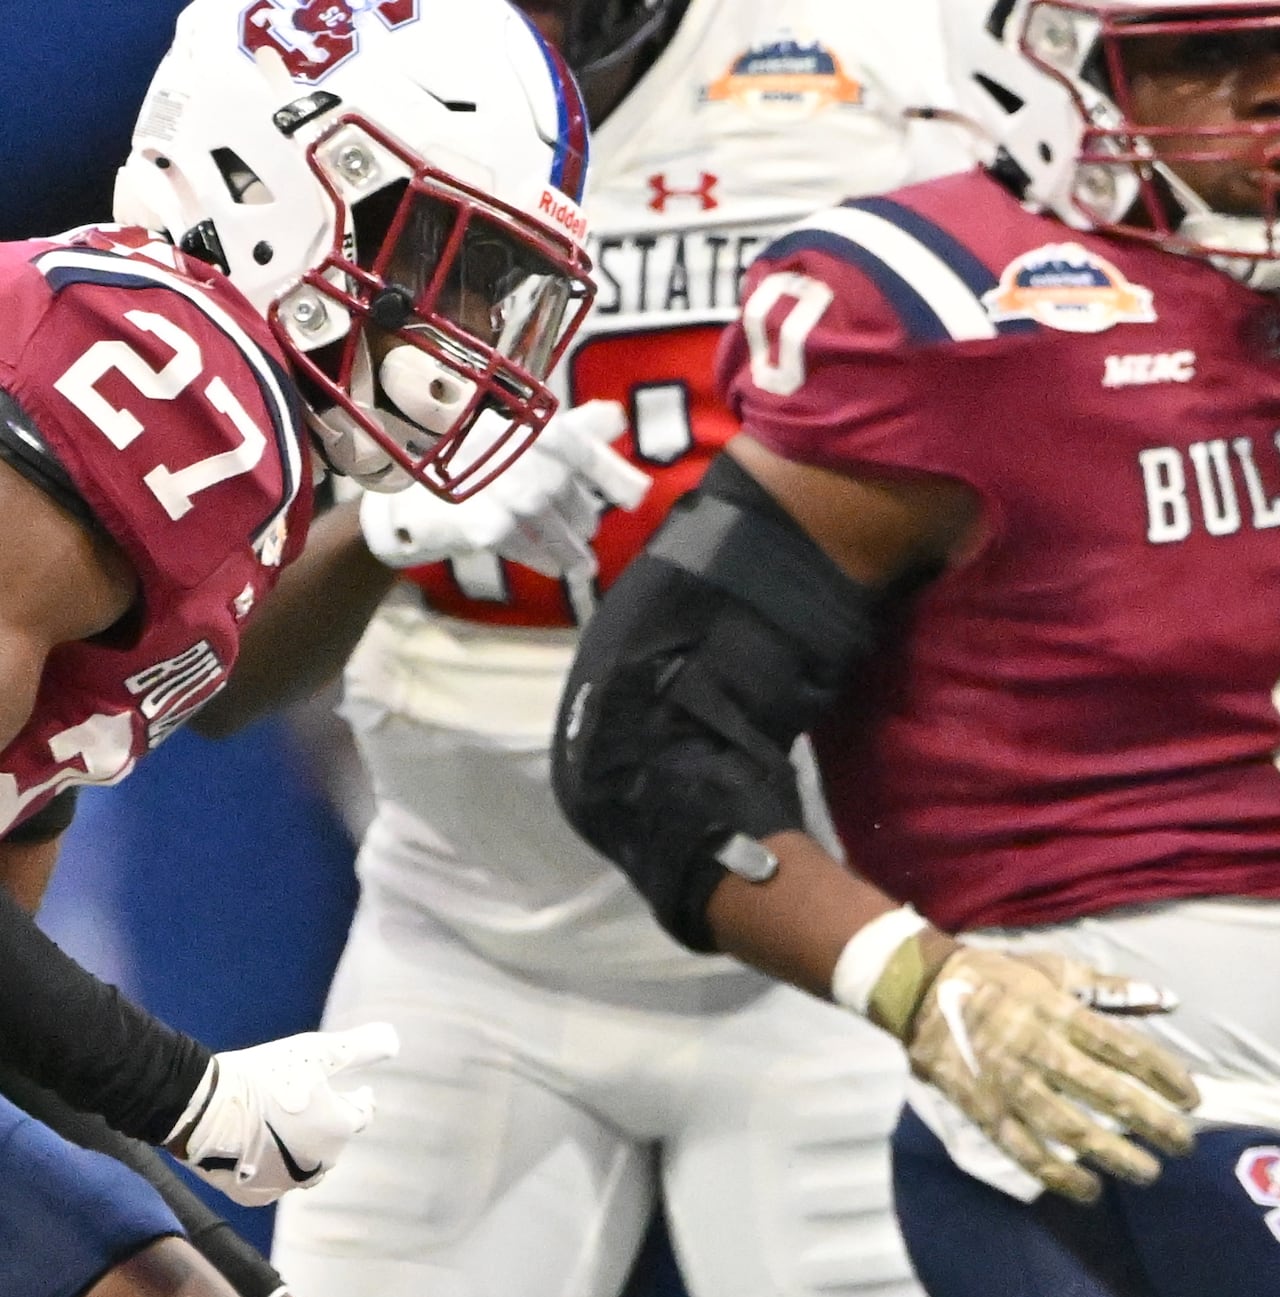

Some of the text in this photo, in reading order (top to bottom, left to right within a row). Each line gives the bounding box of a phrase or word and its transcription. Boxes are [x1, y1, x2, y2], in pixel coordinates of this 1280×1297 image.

[539, 190, 588, 240] Riddell
[743, 271, 835, 398] 0
[53, 309, 266, 522] 27
